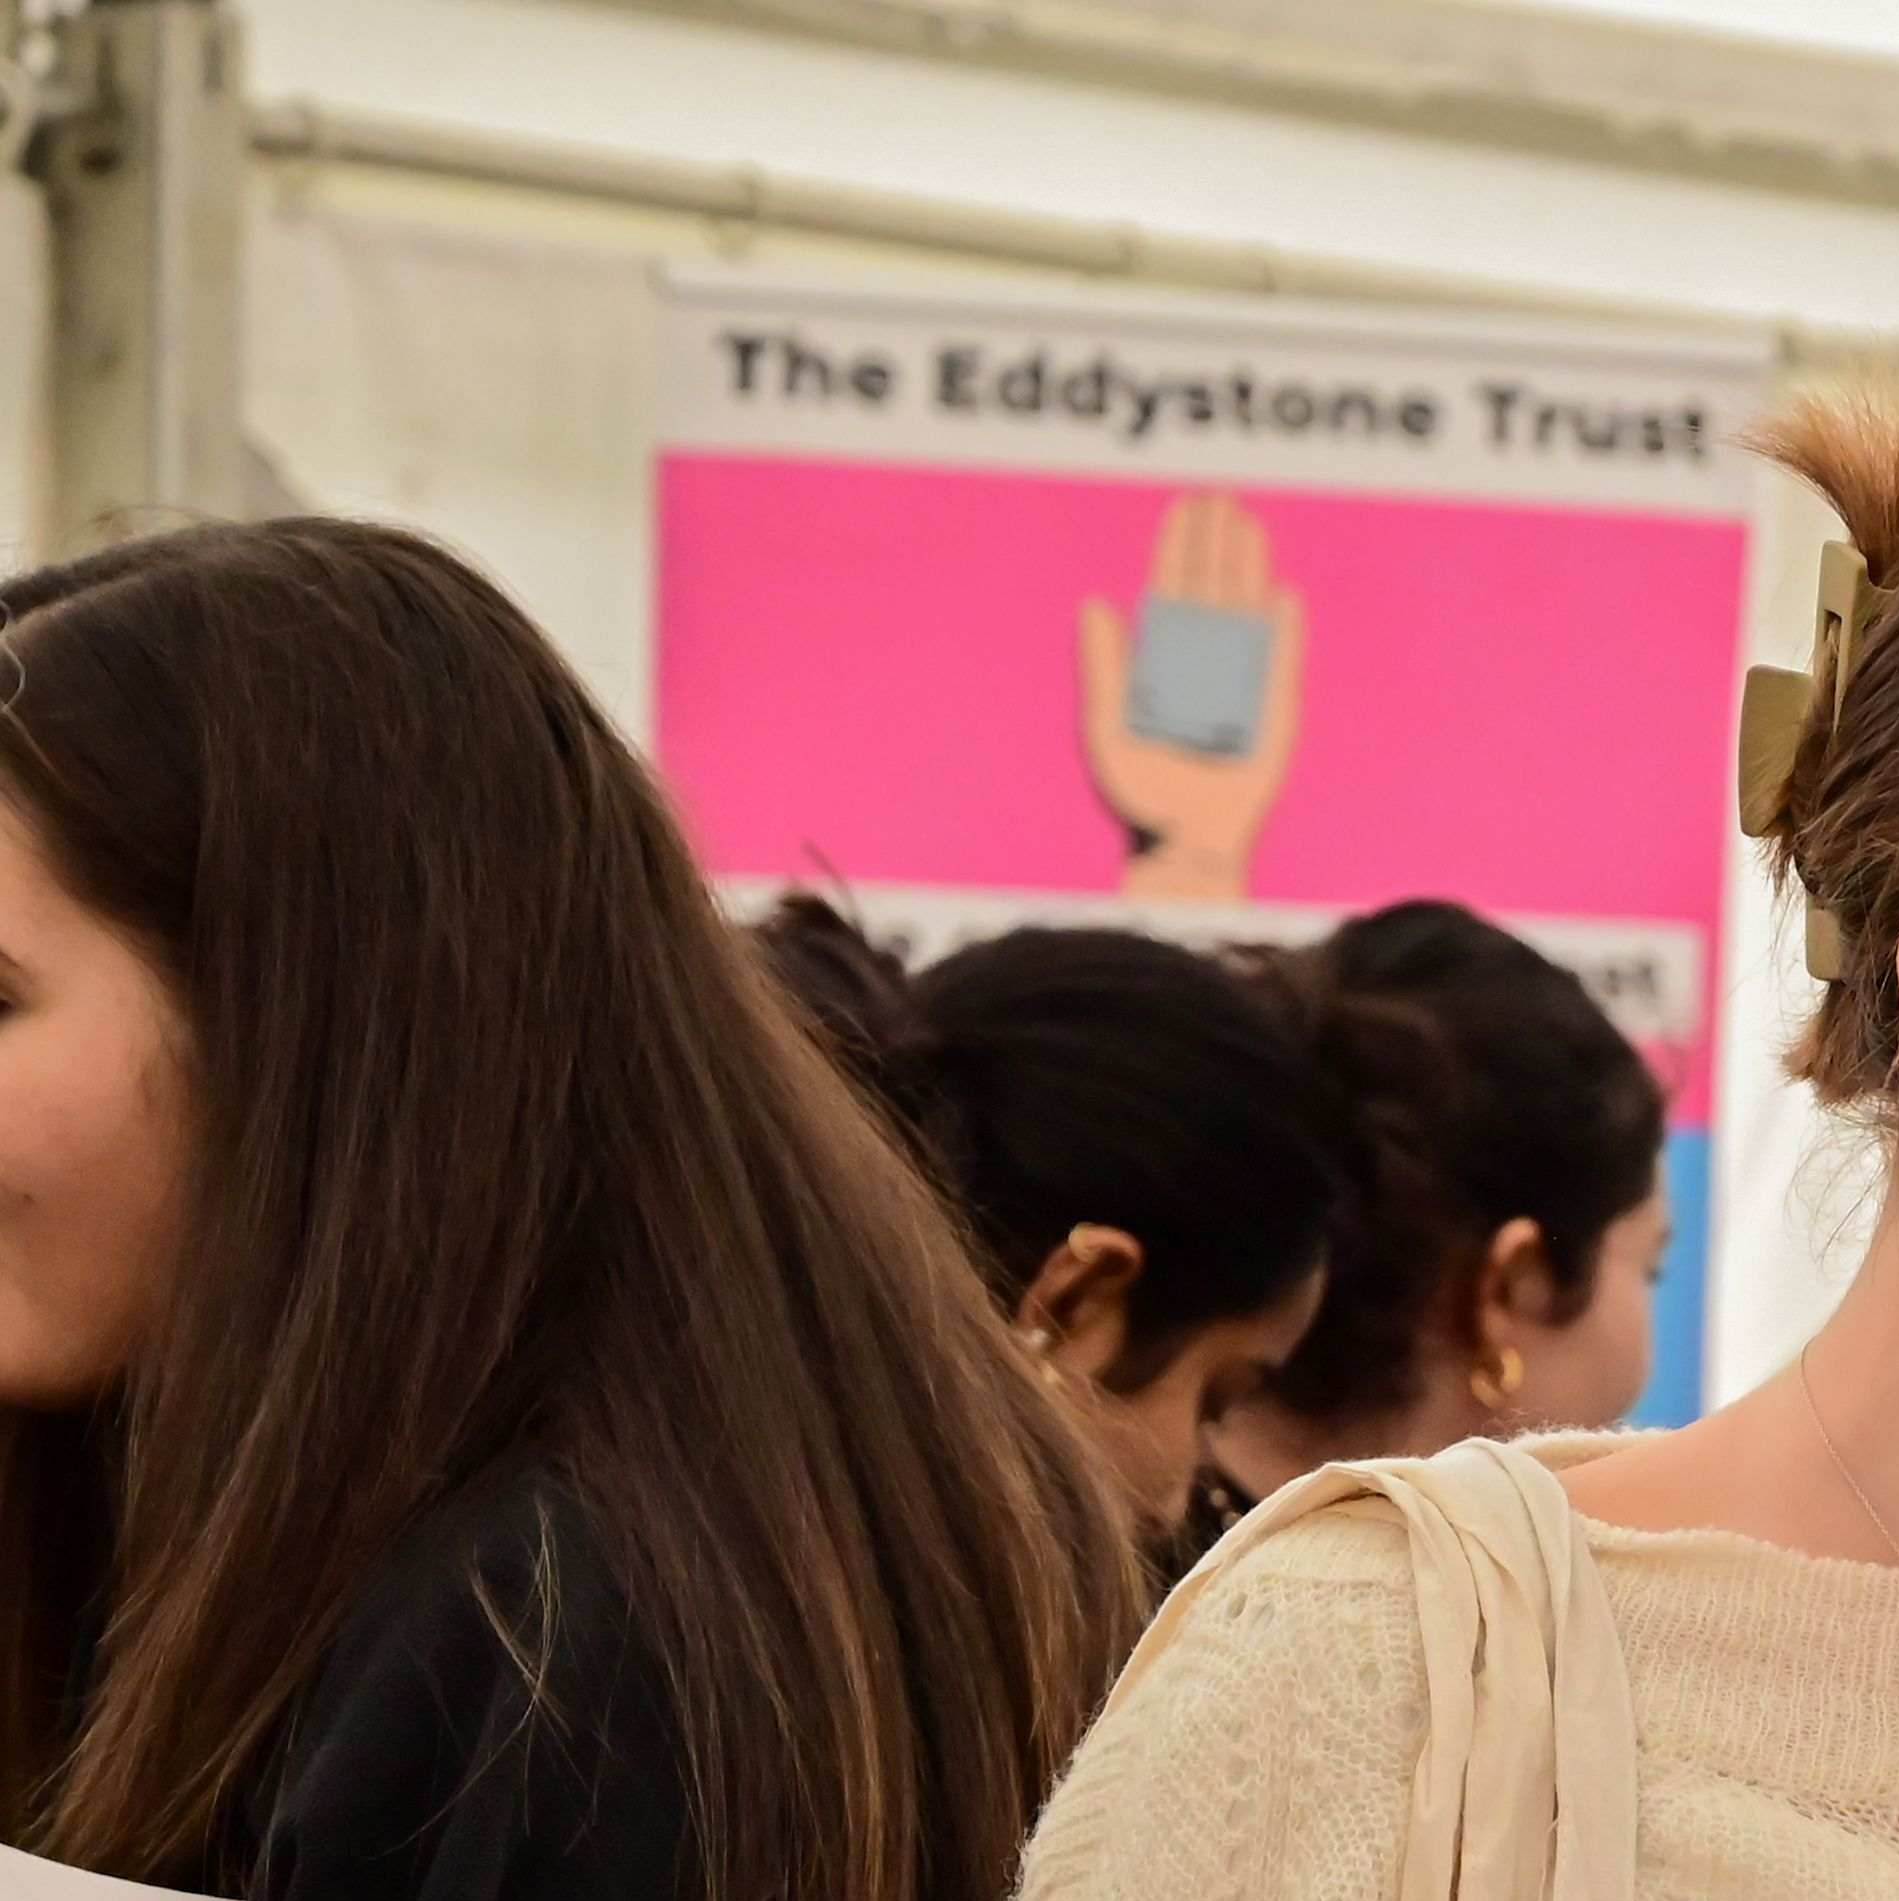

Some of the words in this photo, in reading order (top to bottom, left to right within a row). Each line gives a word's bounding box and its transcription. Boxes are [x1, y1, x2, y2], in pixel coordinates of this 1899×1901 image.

[724, 334, 892, 403] The
[933, 344, 1438, 441] Eddystone
[1476, 381, 1706, 457] Trust
